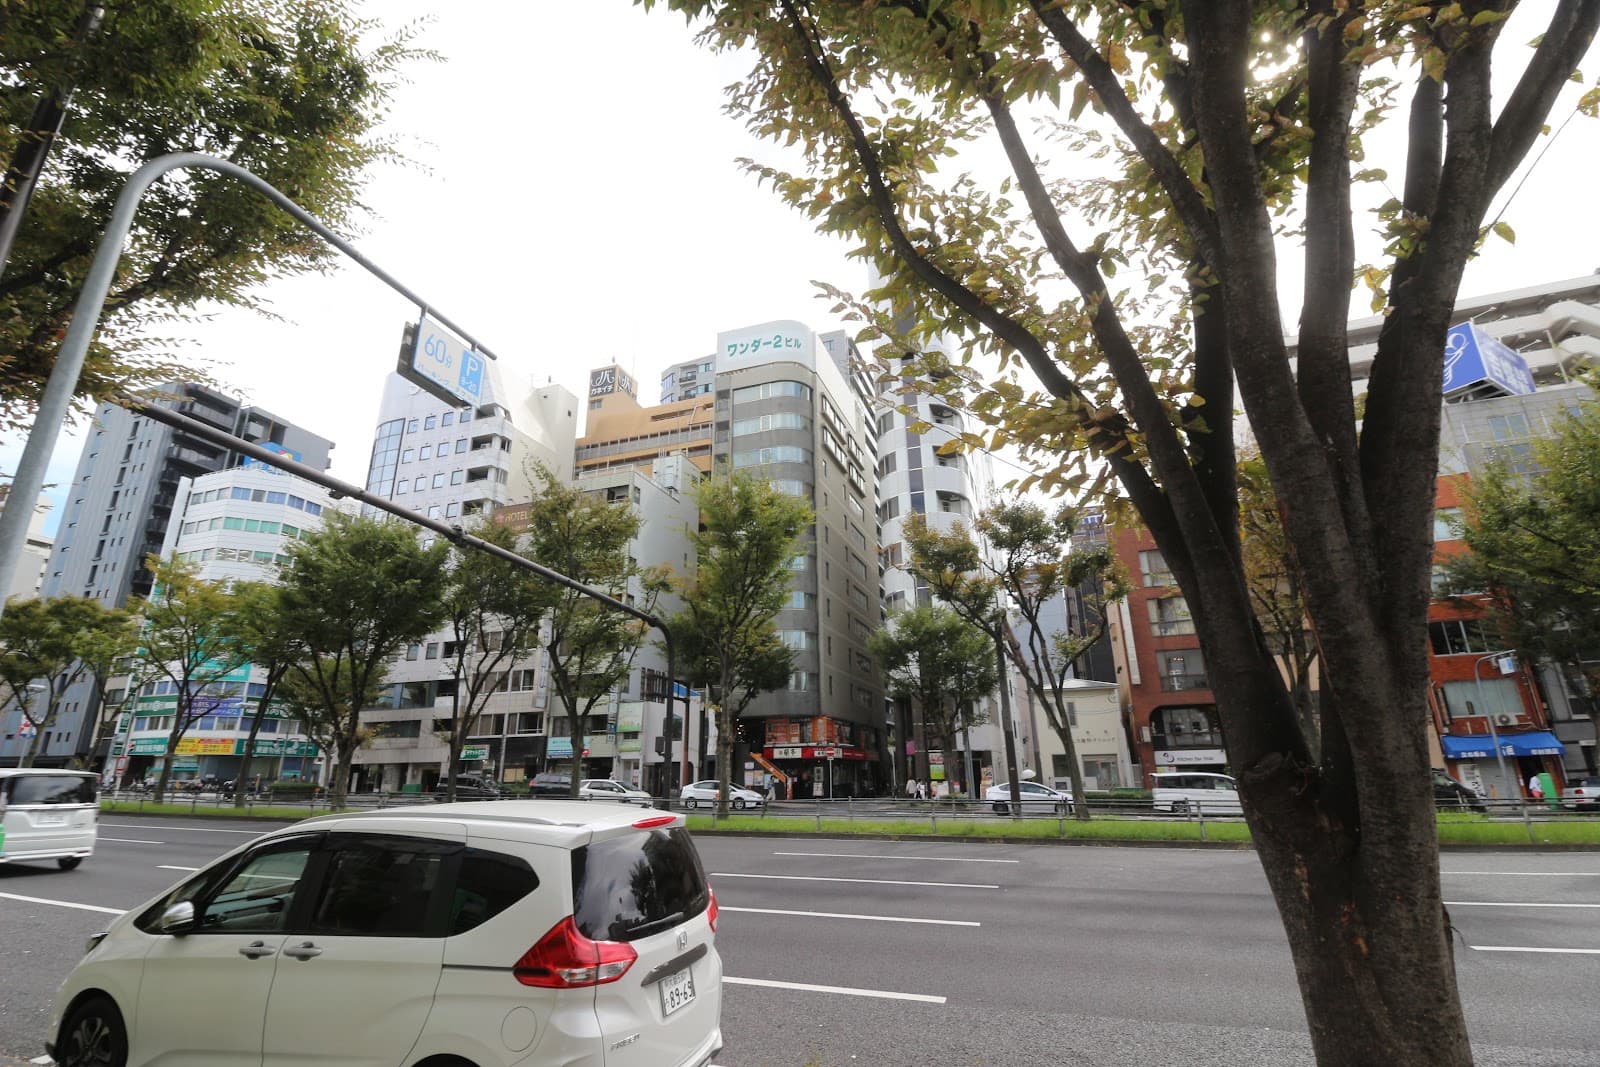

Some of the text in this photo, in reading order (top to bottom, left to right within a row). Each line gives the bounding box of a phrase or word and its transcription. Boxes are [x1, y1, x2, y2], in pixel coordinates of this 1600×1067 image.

[727, 334, 802, 357] ワンダー2ビル
[465, 356, 478, 377] P
